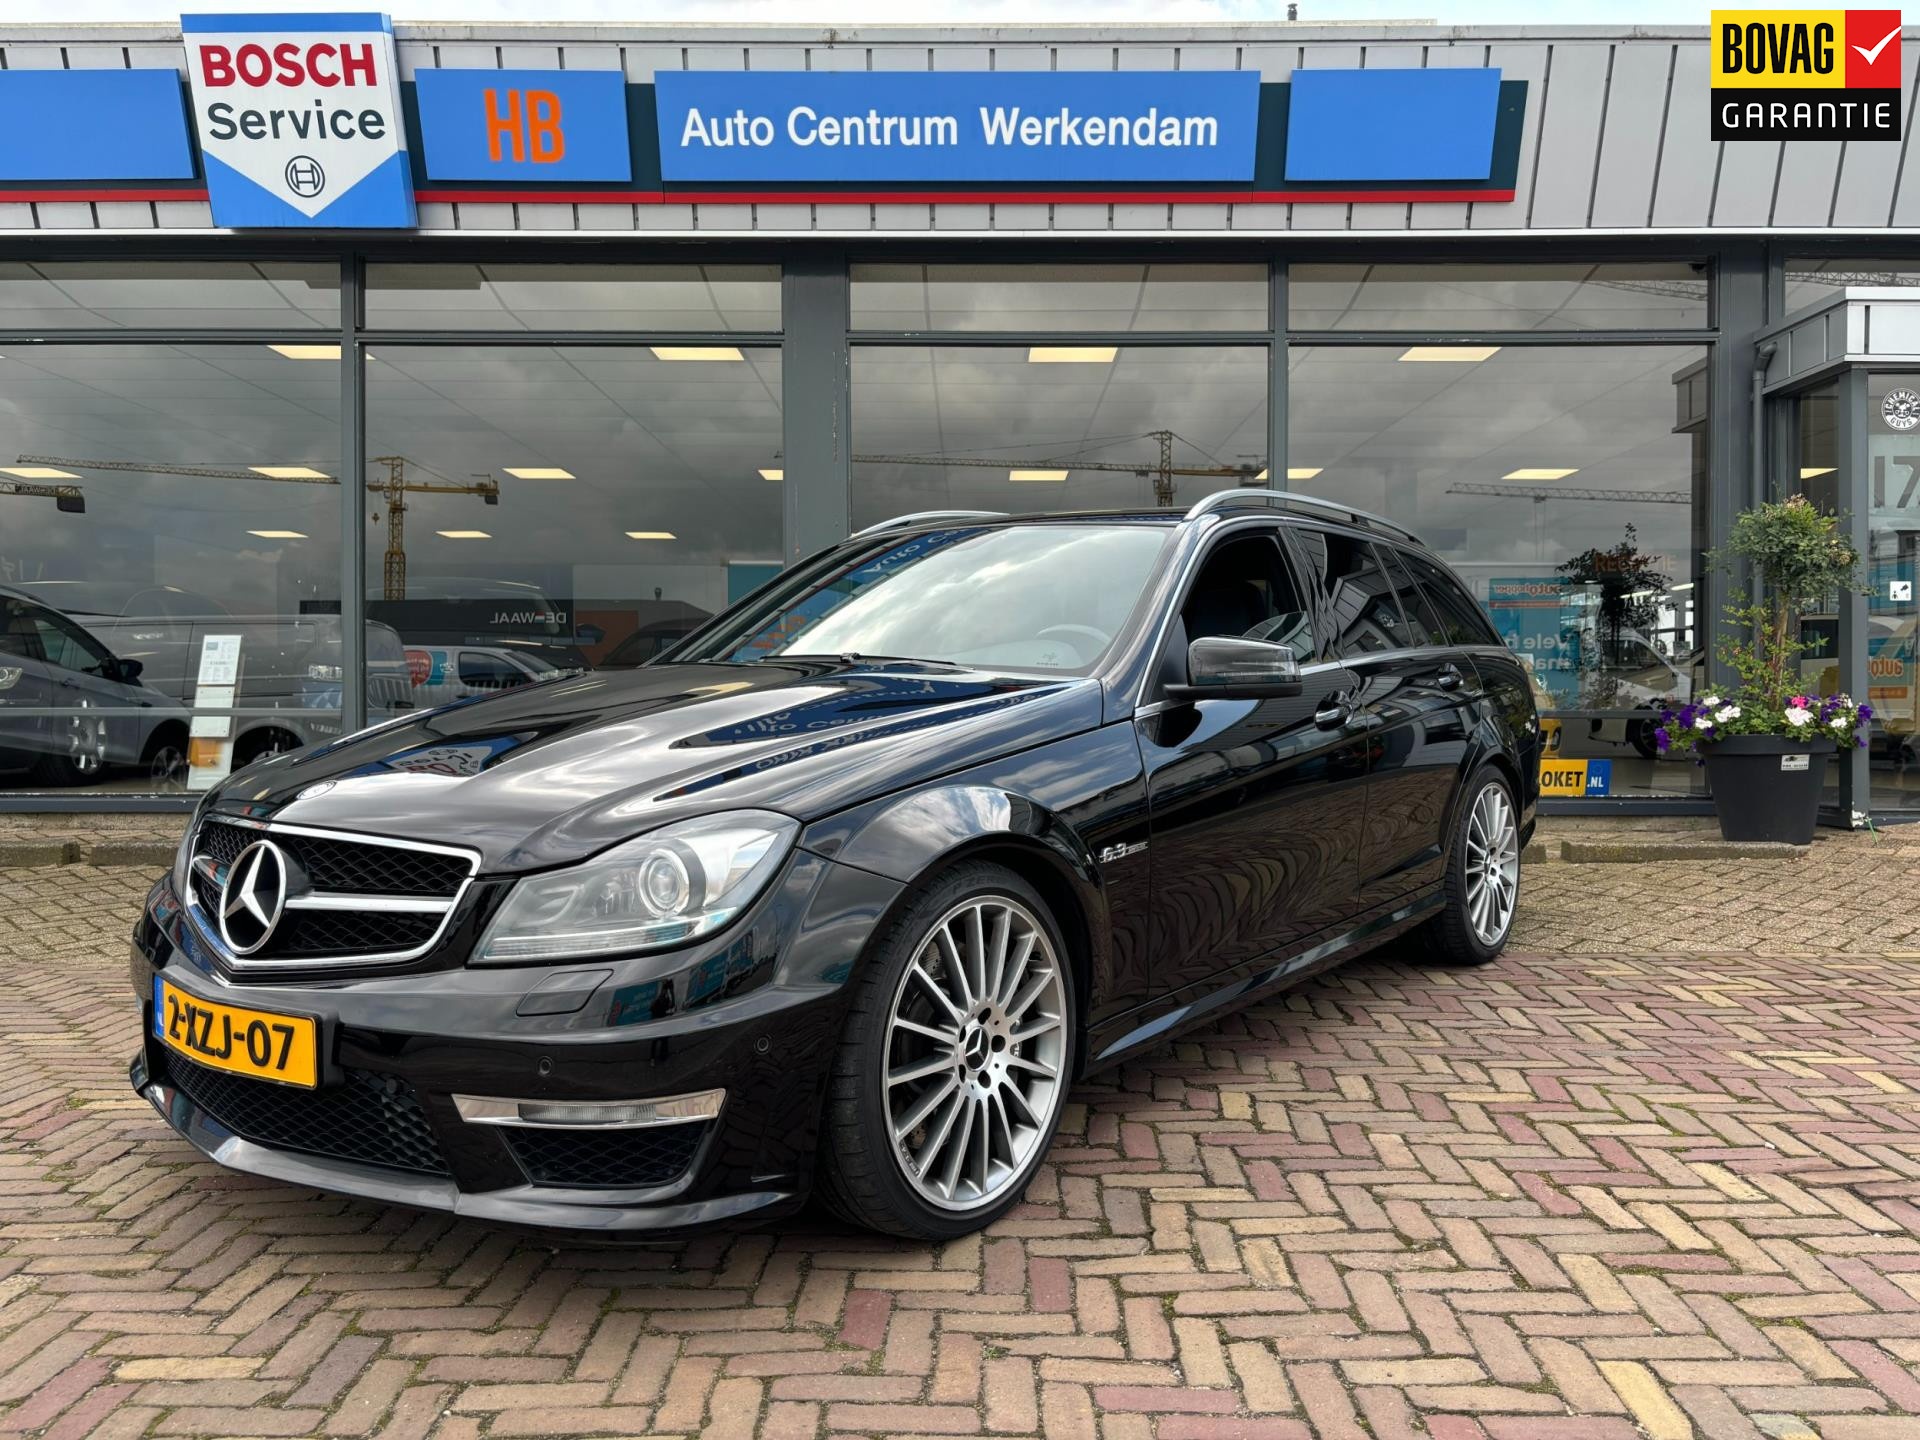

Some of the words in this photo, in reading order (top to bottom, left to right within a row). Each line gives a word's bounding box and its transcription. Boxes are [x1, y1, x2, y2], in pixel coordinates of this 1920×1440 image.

[199, 43, 377, 87] BOSCH
[207, 99, 386, 140] Service
[483, 89, 565, 164] HB
[681, 107, 774, 147] Auto
[787, 106, 958, 147] Centrum
[980, 106, 1218, 147] Werkendam
[1890, 416, 1912, 428] GUYS
[1874, 455, 1920, 508] 17
[168, 994, 295, 1071] 2-XZJ-07
